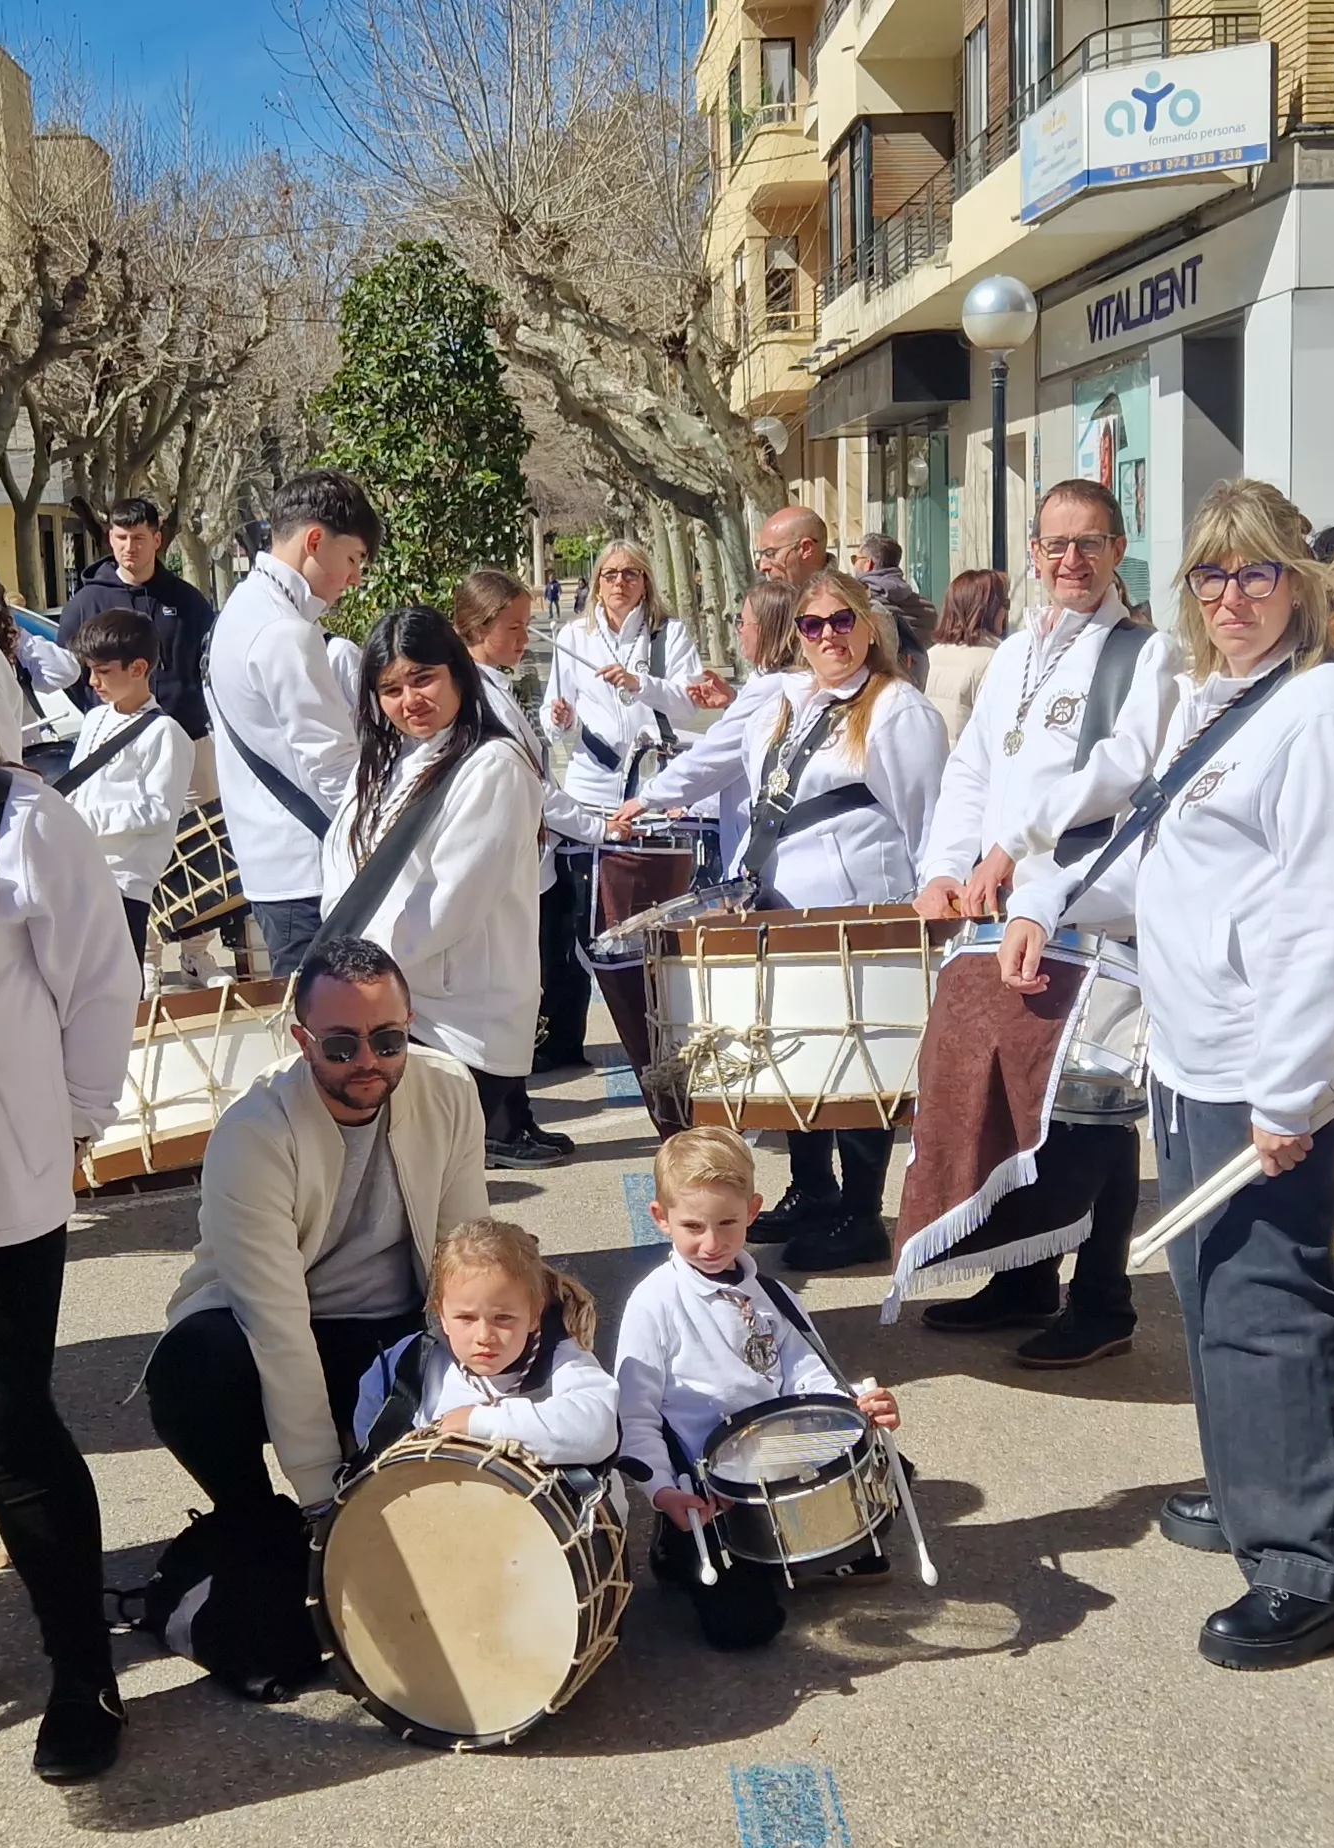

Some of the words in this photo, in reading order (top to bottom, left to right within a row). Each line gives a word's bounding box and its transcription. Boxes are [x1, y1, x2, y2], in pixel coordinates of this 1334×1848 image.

[1148, 129, 1198, 146] formando
[1200, 123, 1247, 142] personas
[1112, 166, 1134, 178] Tel.
[1139, 161, 1162, 173] +34
[1165, 157, 1189, 170] 974
[1193, 153, 1215, 166] 238
[1219, 148, 1243, 163] 238
[1086, 253, 1203, 344] VITALDENT
